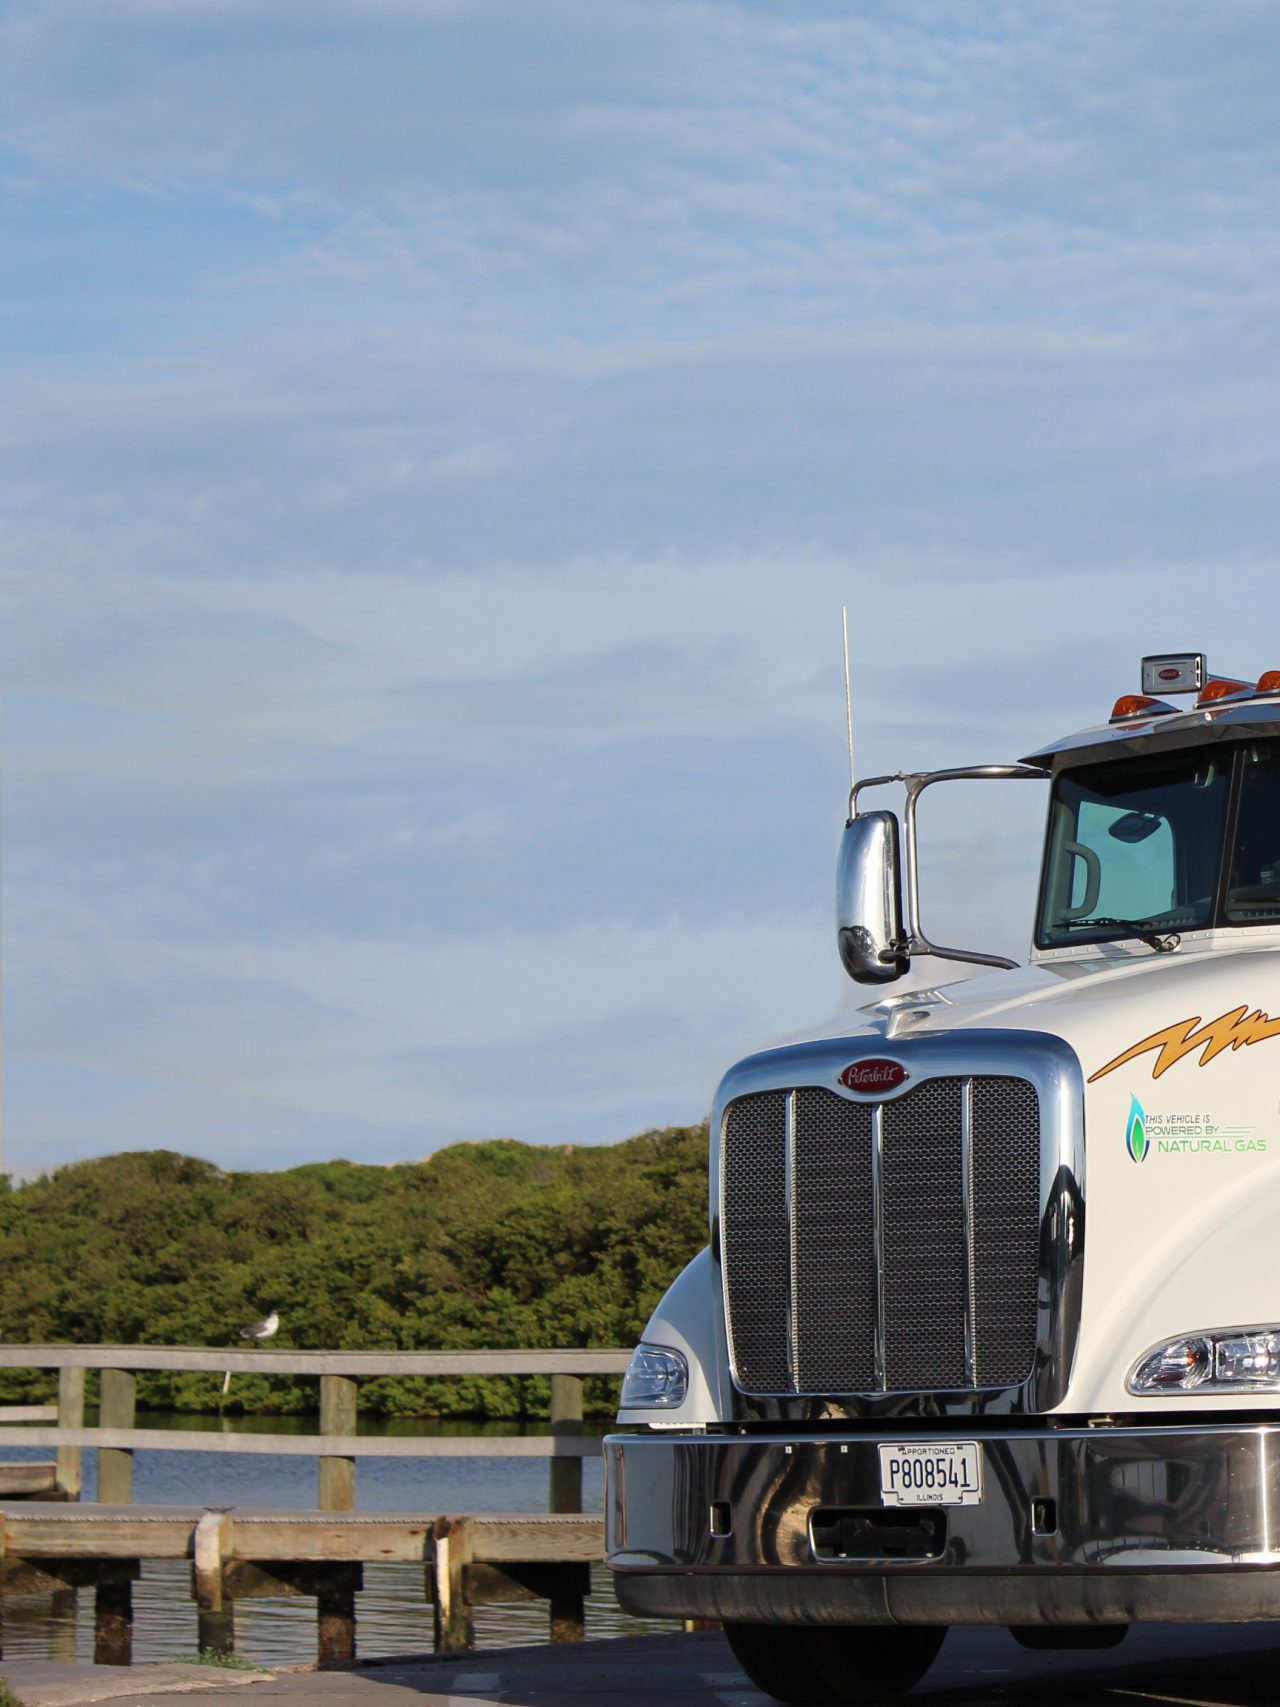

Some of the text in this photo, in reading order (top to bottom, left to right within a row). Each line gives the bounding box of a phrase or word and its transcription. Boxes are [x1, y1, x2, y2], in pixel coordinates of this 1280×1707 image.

[847, 1066, 899, 1086] Peterbilt
[1145, 1114, 1211, 1124] THIS VEHICLE IS
[1145, 1125, 1220, 1135] POWERED BY
[1158, 1139, 1267, 1152] NATURAL GAS
[901, 1447, 956, 1455] APPORTIONED
[889, 1457, 971, 1489] P808541
[916, 1493, 944, 1502] ILLINOIS
